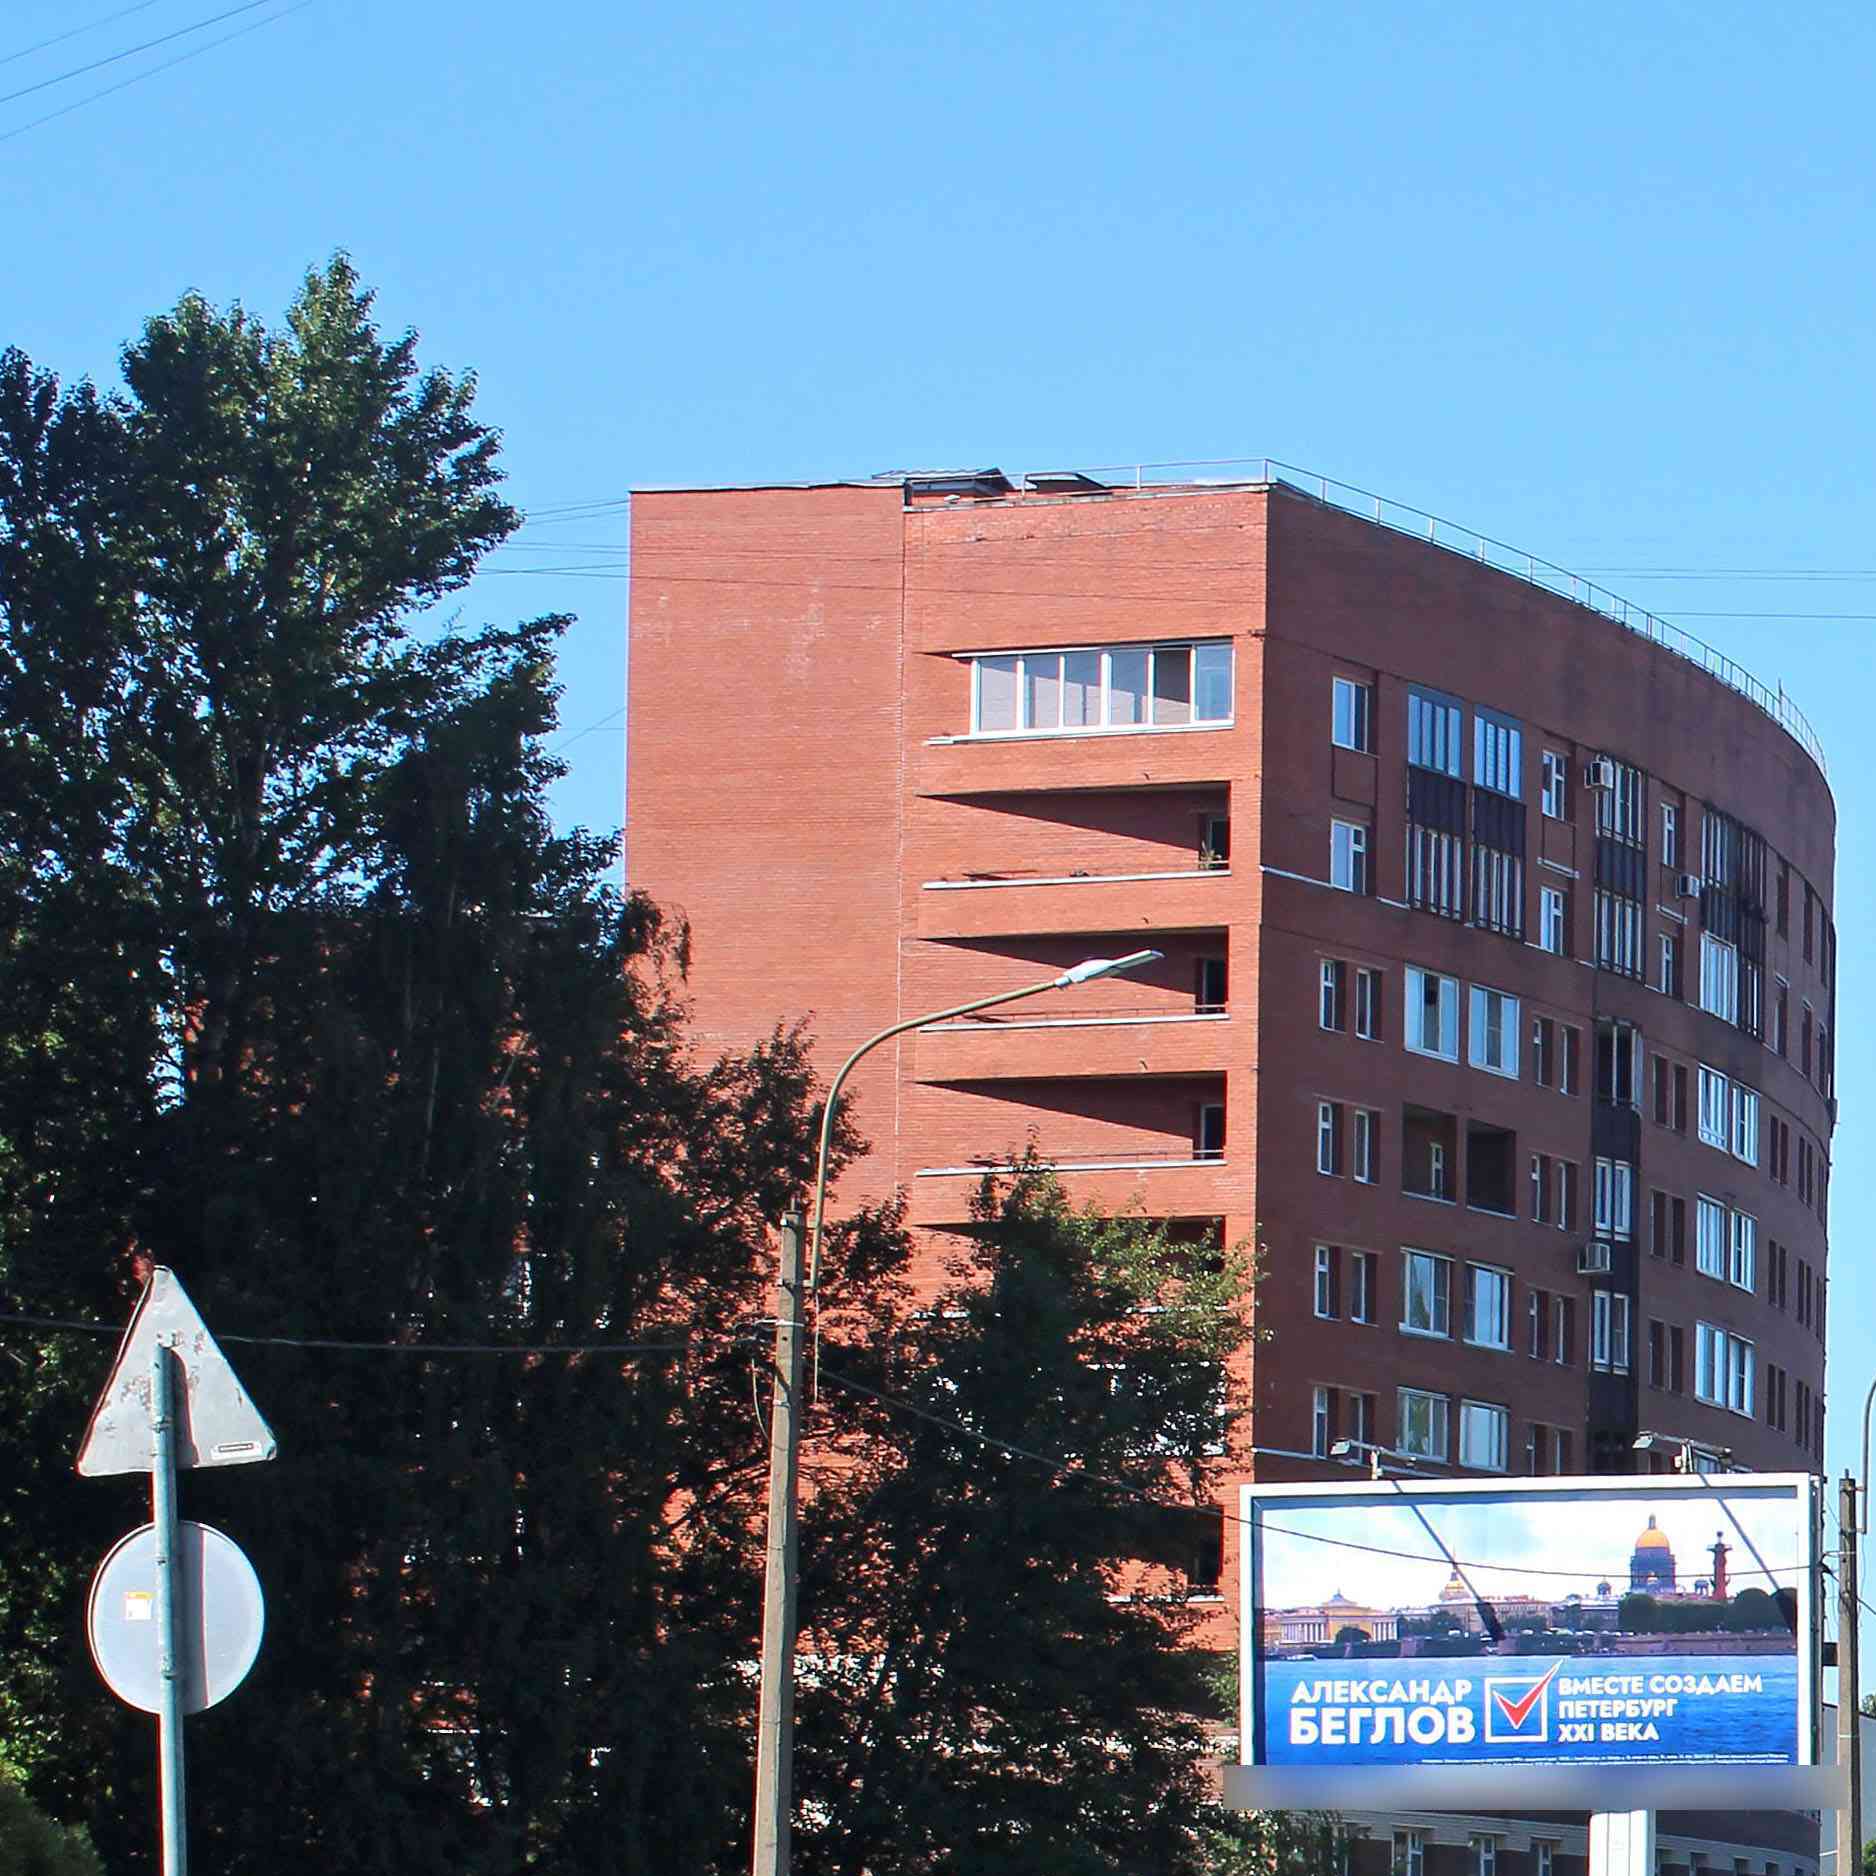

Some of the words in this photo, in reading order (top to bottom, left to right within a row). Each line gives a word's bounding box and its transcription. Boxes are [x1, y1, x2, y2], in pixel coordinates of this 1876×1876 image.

[1290, 1679, 1472, 1704] АЛЕКСАНДР
[1558, 1676, 1644, 1695] ВМЕСТЕ
[1649, 1674, 1763, 1695] СОЗДАЕМ
[1558, 1698, 1679, 1719] ПЕТЕРБУРГ
[1289, 1706, 1476, 1745] БЕГЛОВ
[1558, 1723, 1595, 1742] XXI
[1600, 1722, 1660, 1741] ВЕКА
